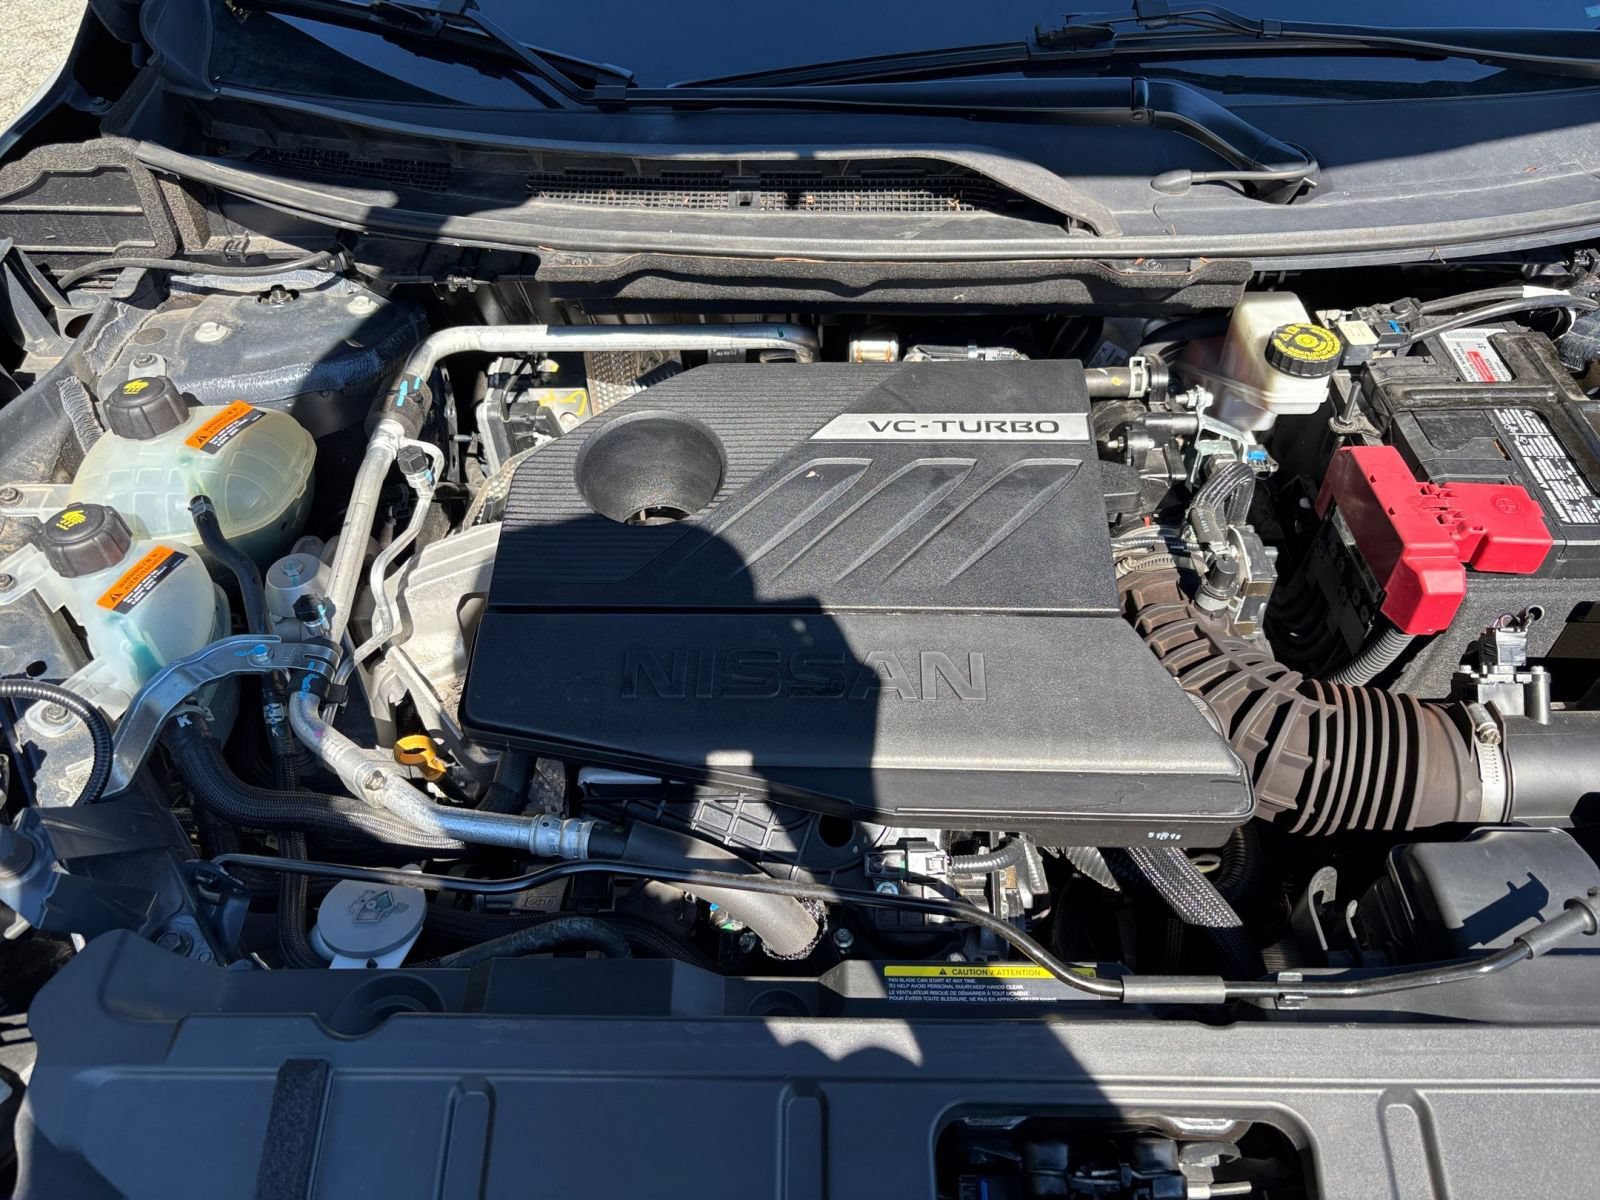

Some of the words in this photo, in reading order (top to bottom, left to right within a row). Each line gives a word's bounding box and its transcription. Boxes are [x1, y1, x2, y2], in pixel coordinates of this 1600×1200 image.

[867, 419, 1060, 434] VC-TURBO
[620, 649, 988, 701] NISSAN
[951, 968, 988, 976] CAUTION
[996, 968, 1041, 976] ATTENTION
